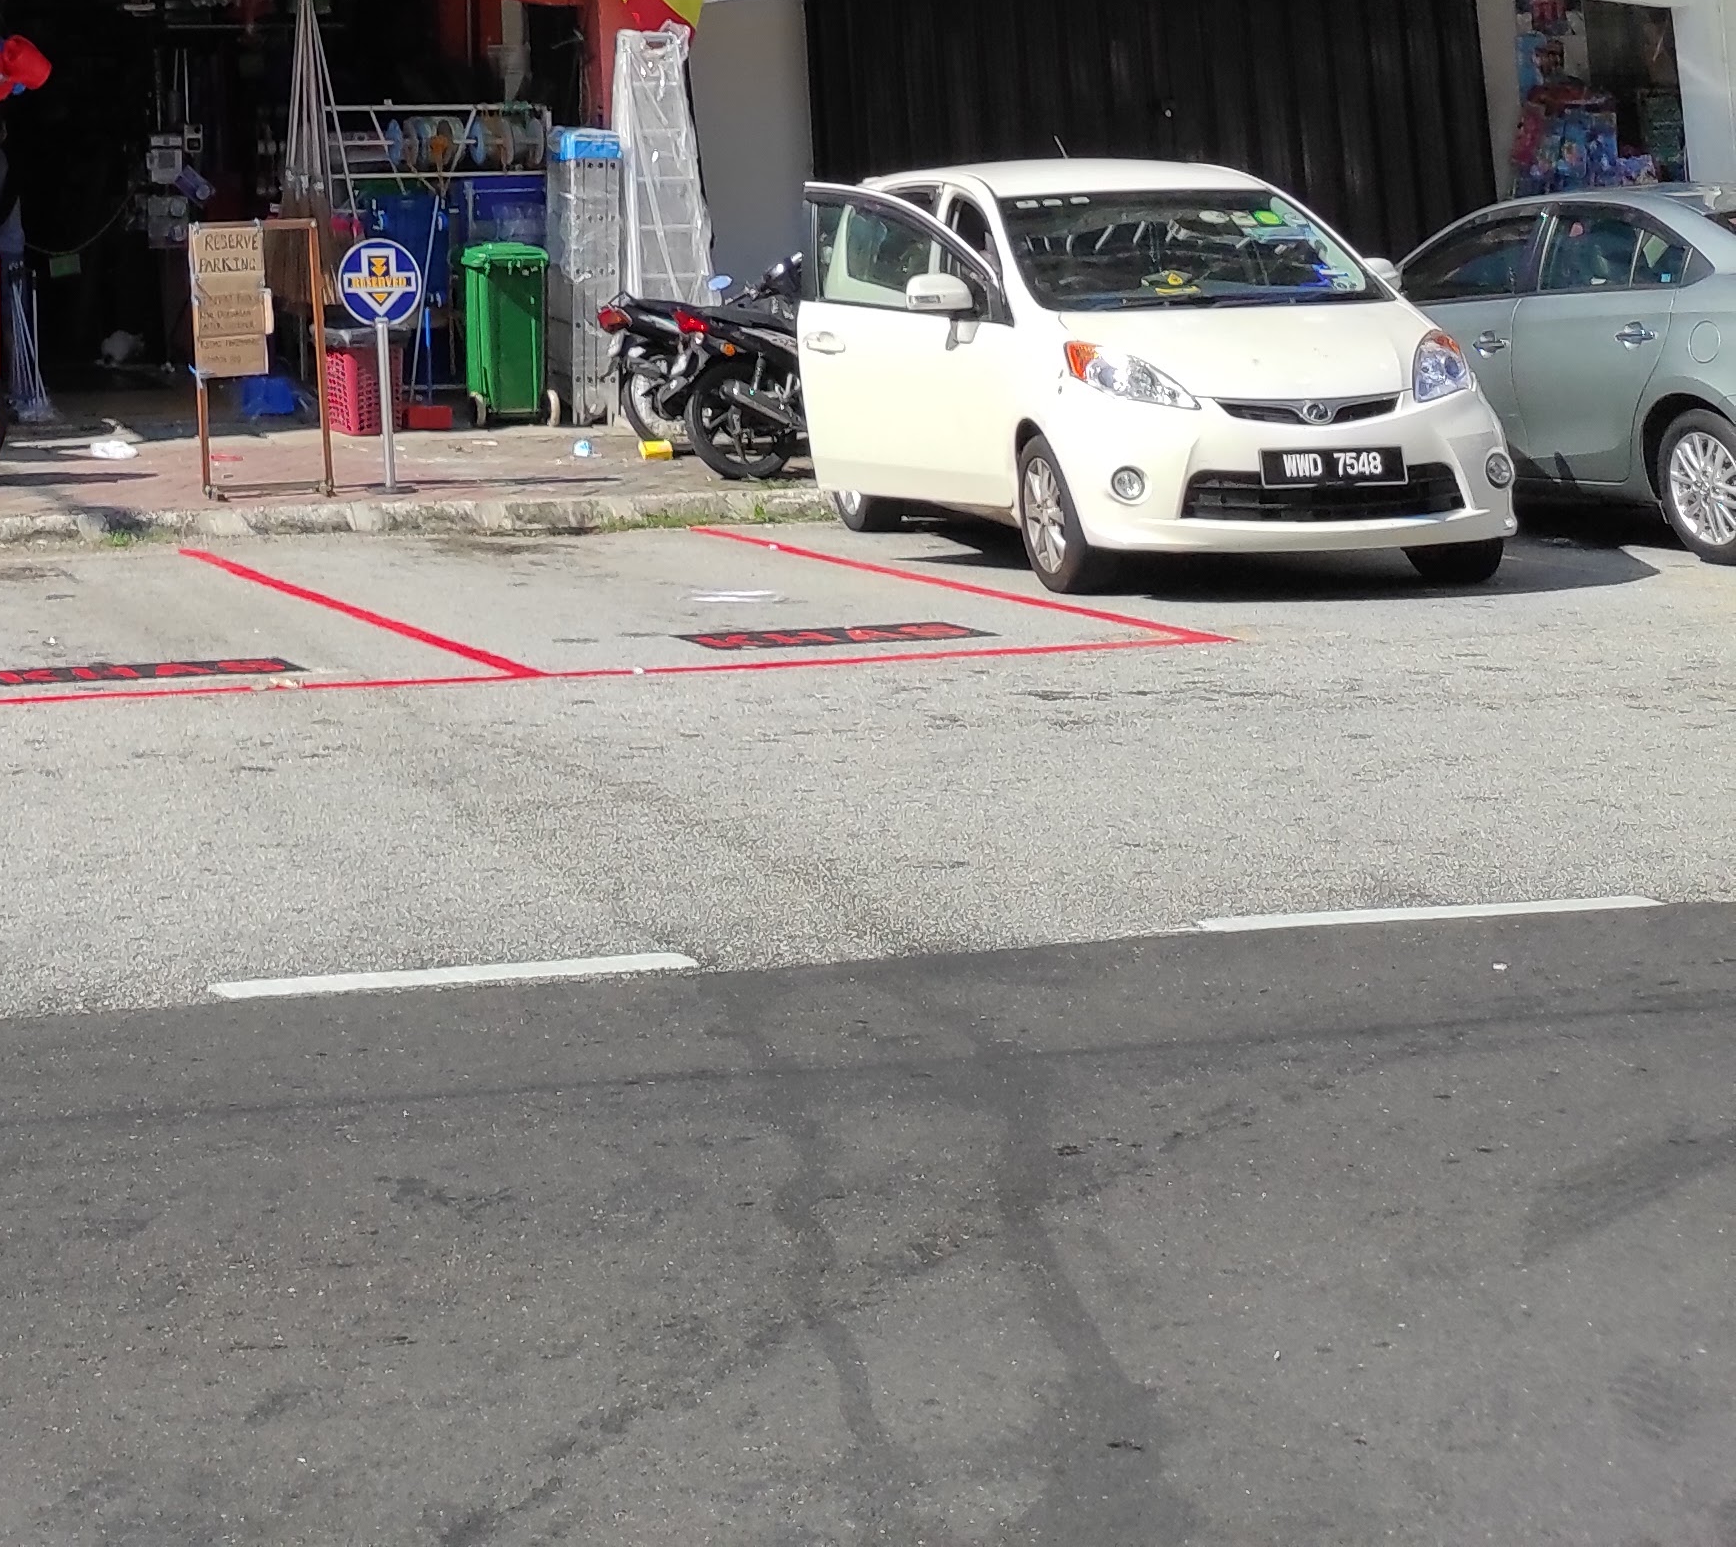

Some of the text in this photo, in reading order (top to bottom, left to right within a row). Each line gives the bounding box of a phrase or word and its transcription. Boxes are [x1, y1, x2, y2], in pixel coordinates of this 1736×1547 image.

[205, 233, 259, 251] RESERVE
[198, 256, 256, 273] PARKING
[1282, 451, 1383, 478] WWD 7548
